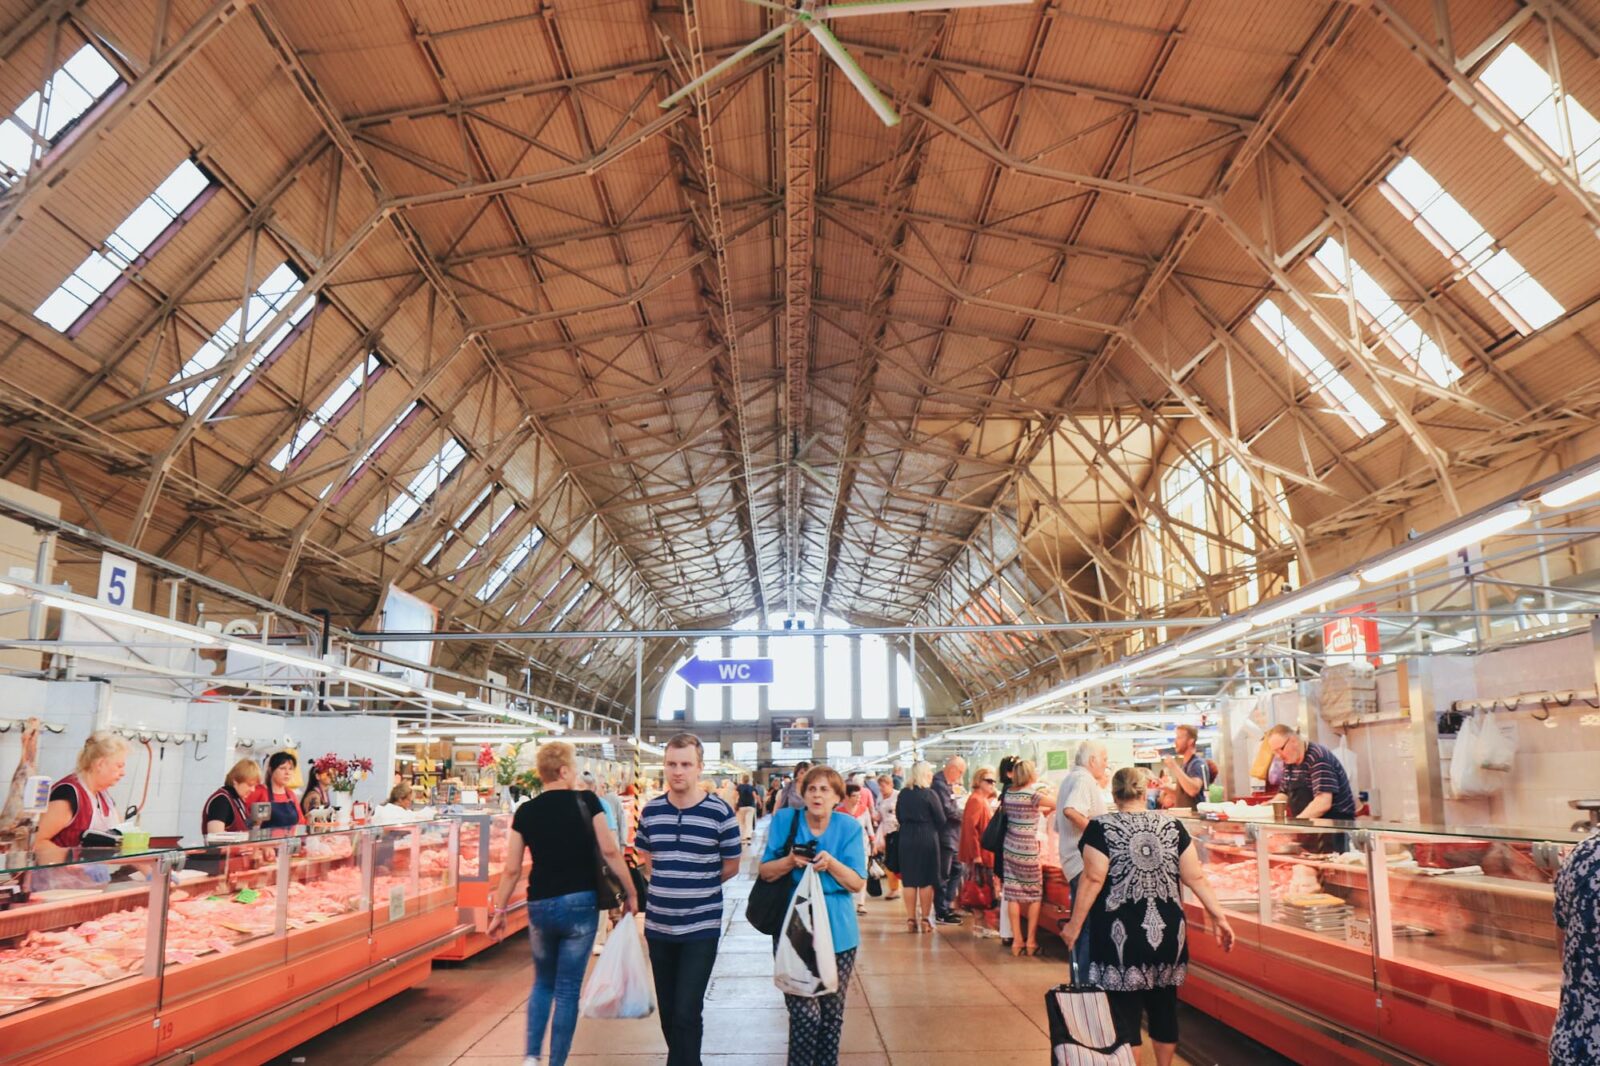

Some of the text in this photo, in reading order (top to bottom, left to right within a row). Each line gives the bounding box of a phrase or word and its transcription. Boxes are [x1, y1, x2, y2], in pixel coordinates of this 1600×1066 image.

[107, 566, 127, 606] 5
[718, 663, 751, 680] WC
[161, 1022, 173, 1040] 19
